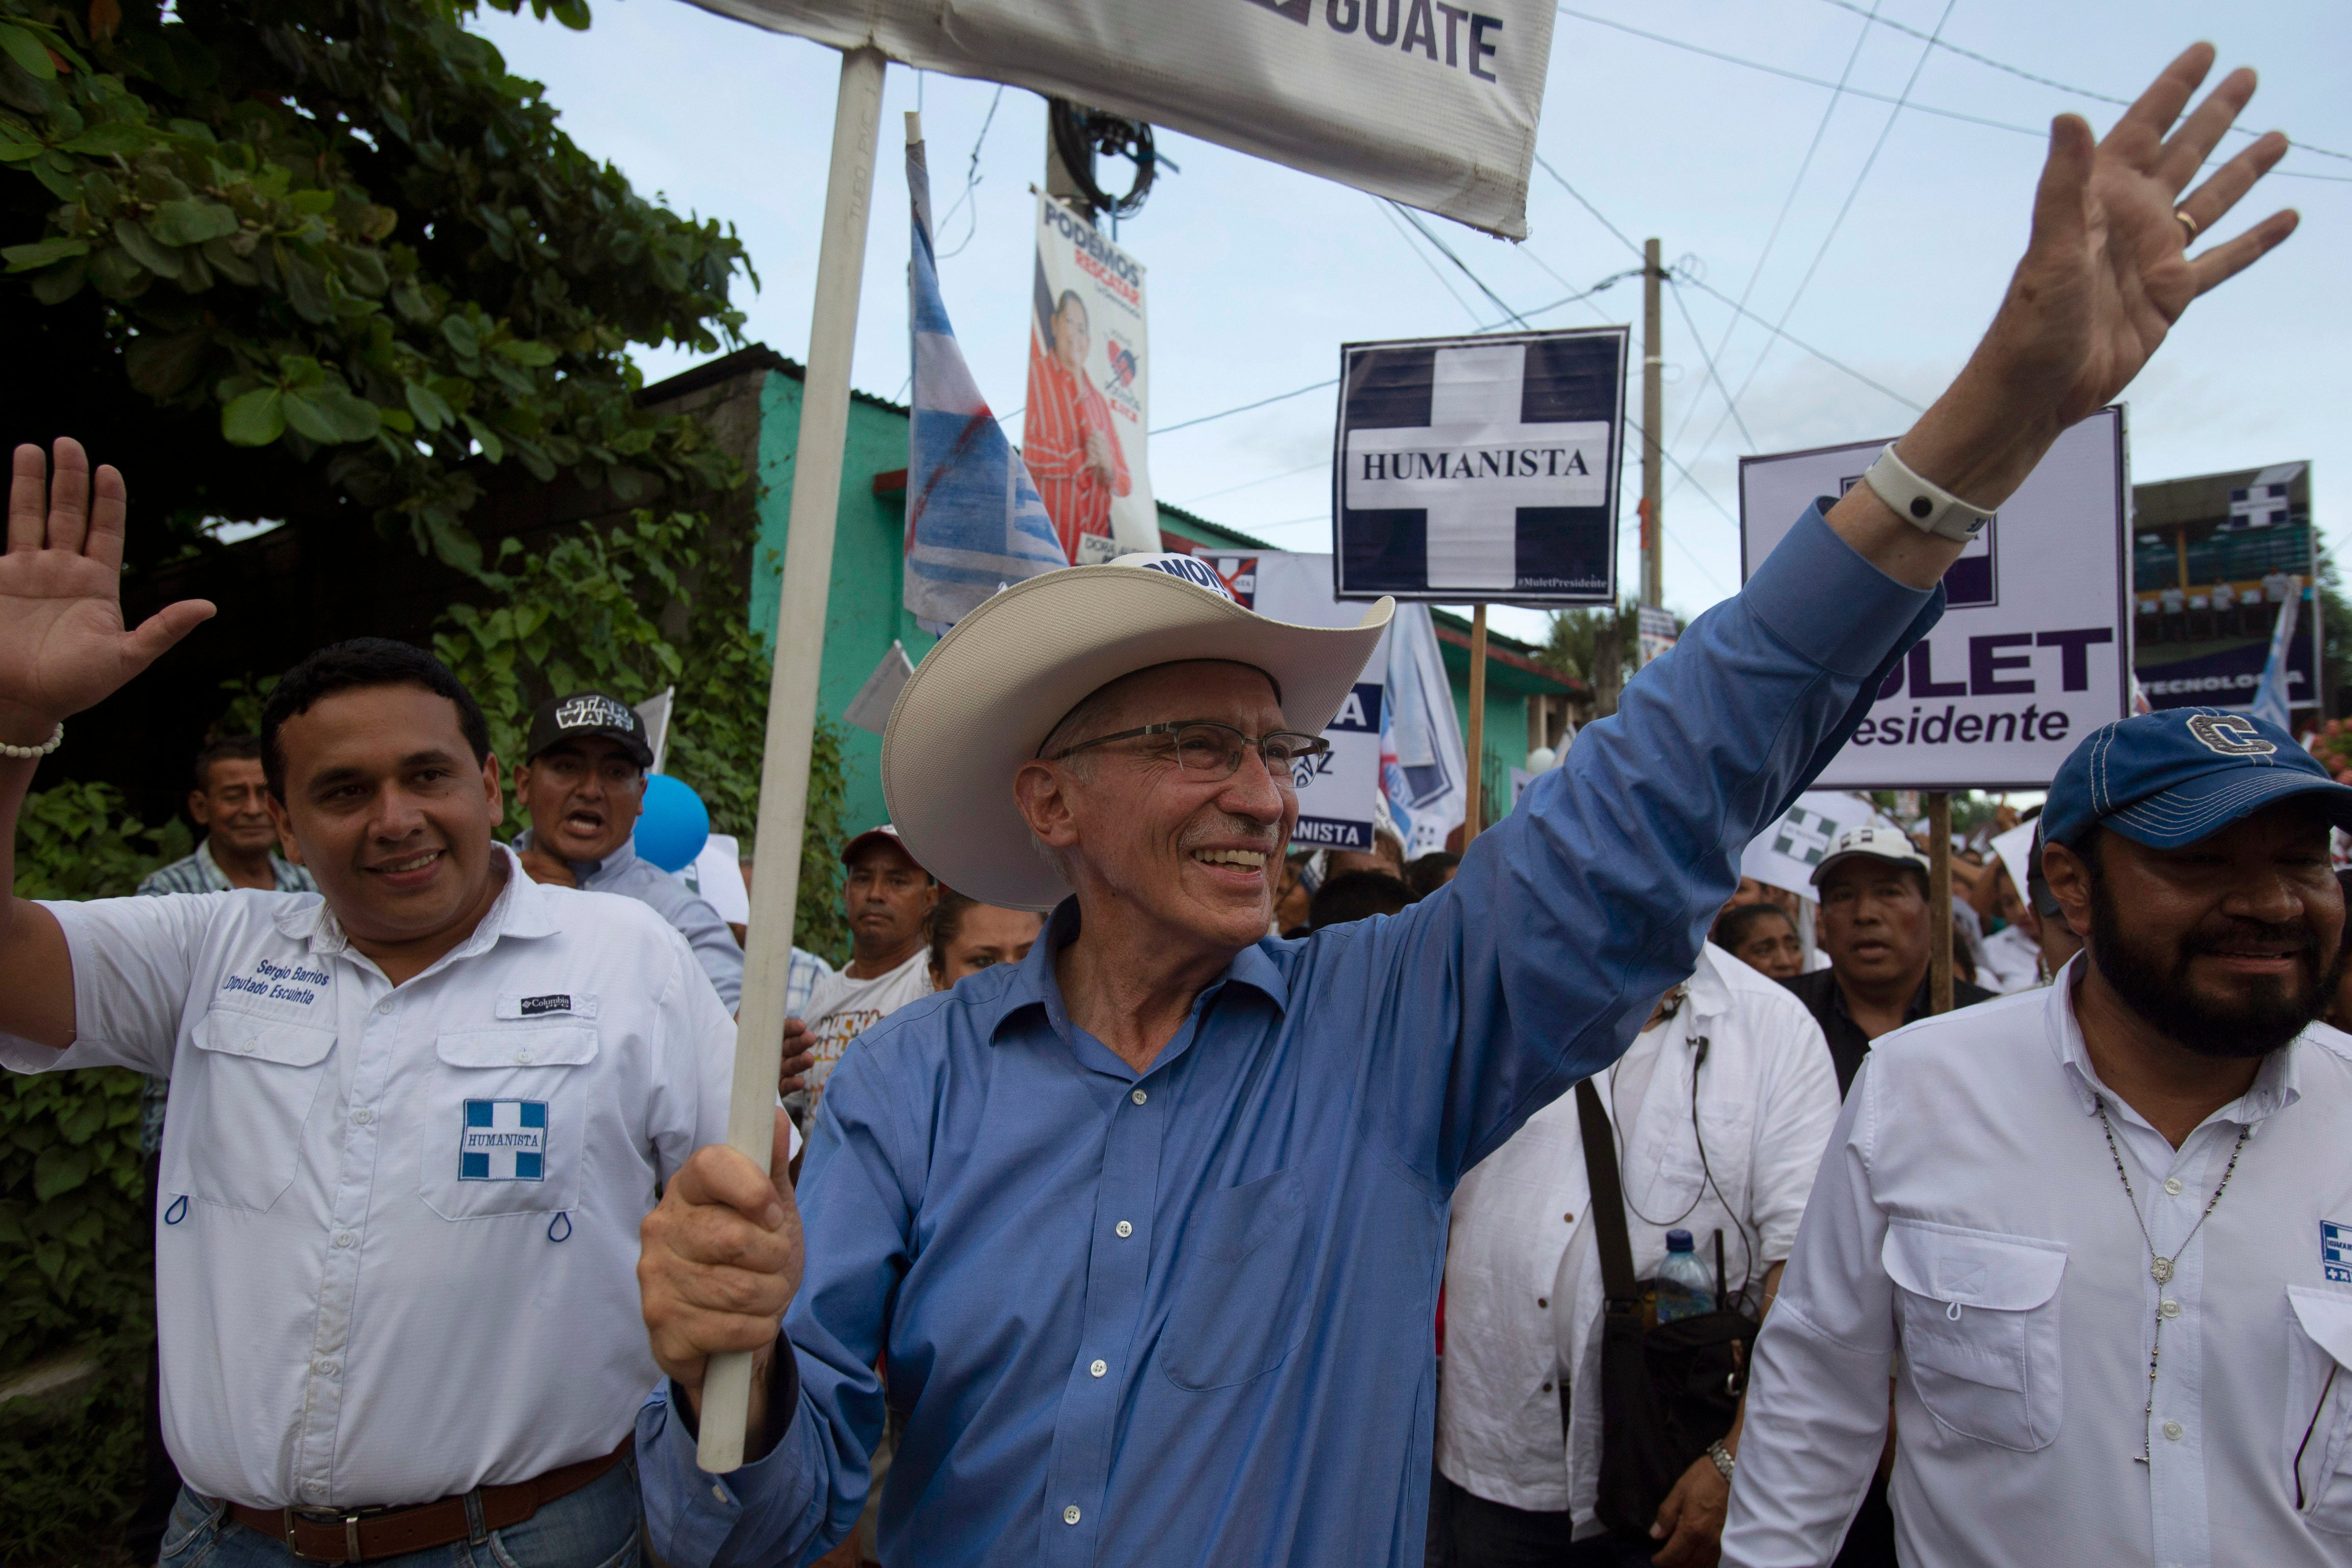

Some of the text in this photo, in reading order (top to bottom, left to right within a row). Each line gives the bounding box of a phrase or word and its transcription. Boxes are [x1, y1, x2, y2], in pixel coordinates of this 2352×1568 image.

[1044, 200, 1139, 288] PODEMOS
[1362, 449, 1590, 480] HUMANISTA
[556, 708, 634, 731] WARS
[557, 694, 629, 718] STAR
[1850, 704, 2070, 746] esidente
[2185, 715, 2278, 756] C
[256, 959, 329, 986] Sergio Barrios
[223, 975, 315, 1005] Diputado Escuintla
[532, 997, 569, 1007] Columbia
[467, 1133, 538, 1146] HUMANISTA
